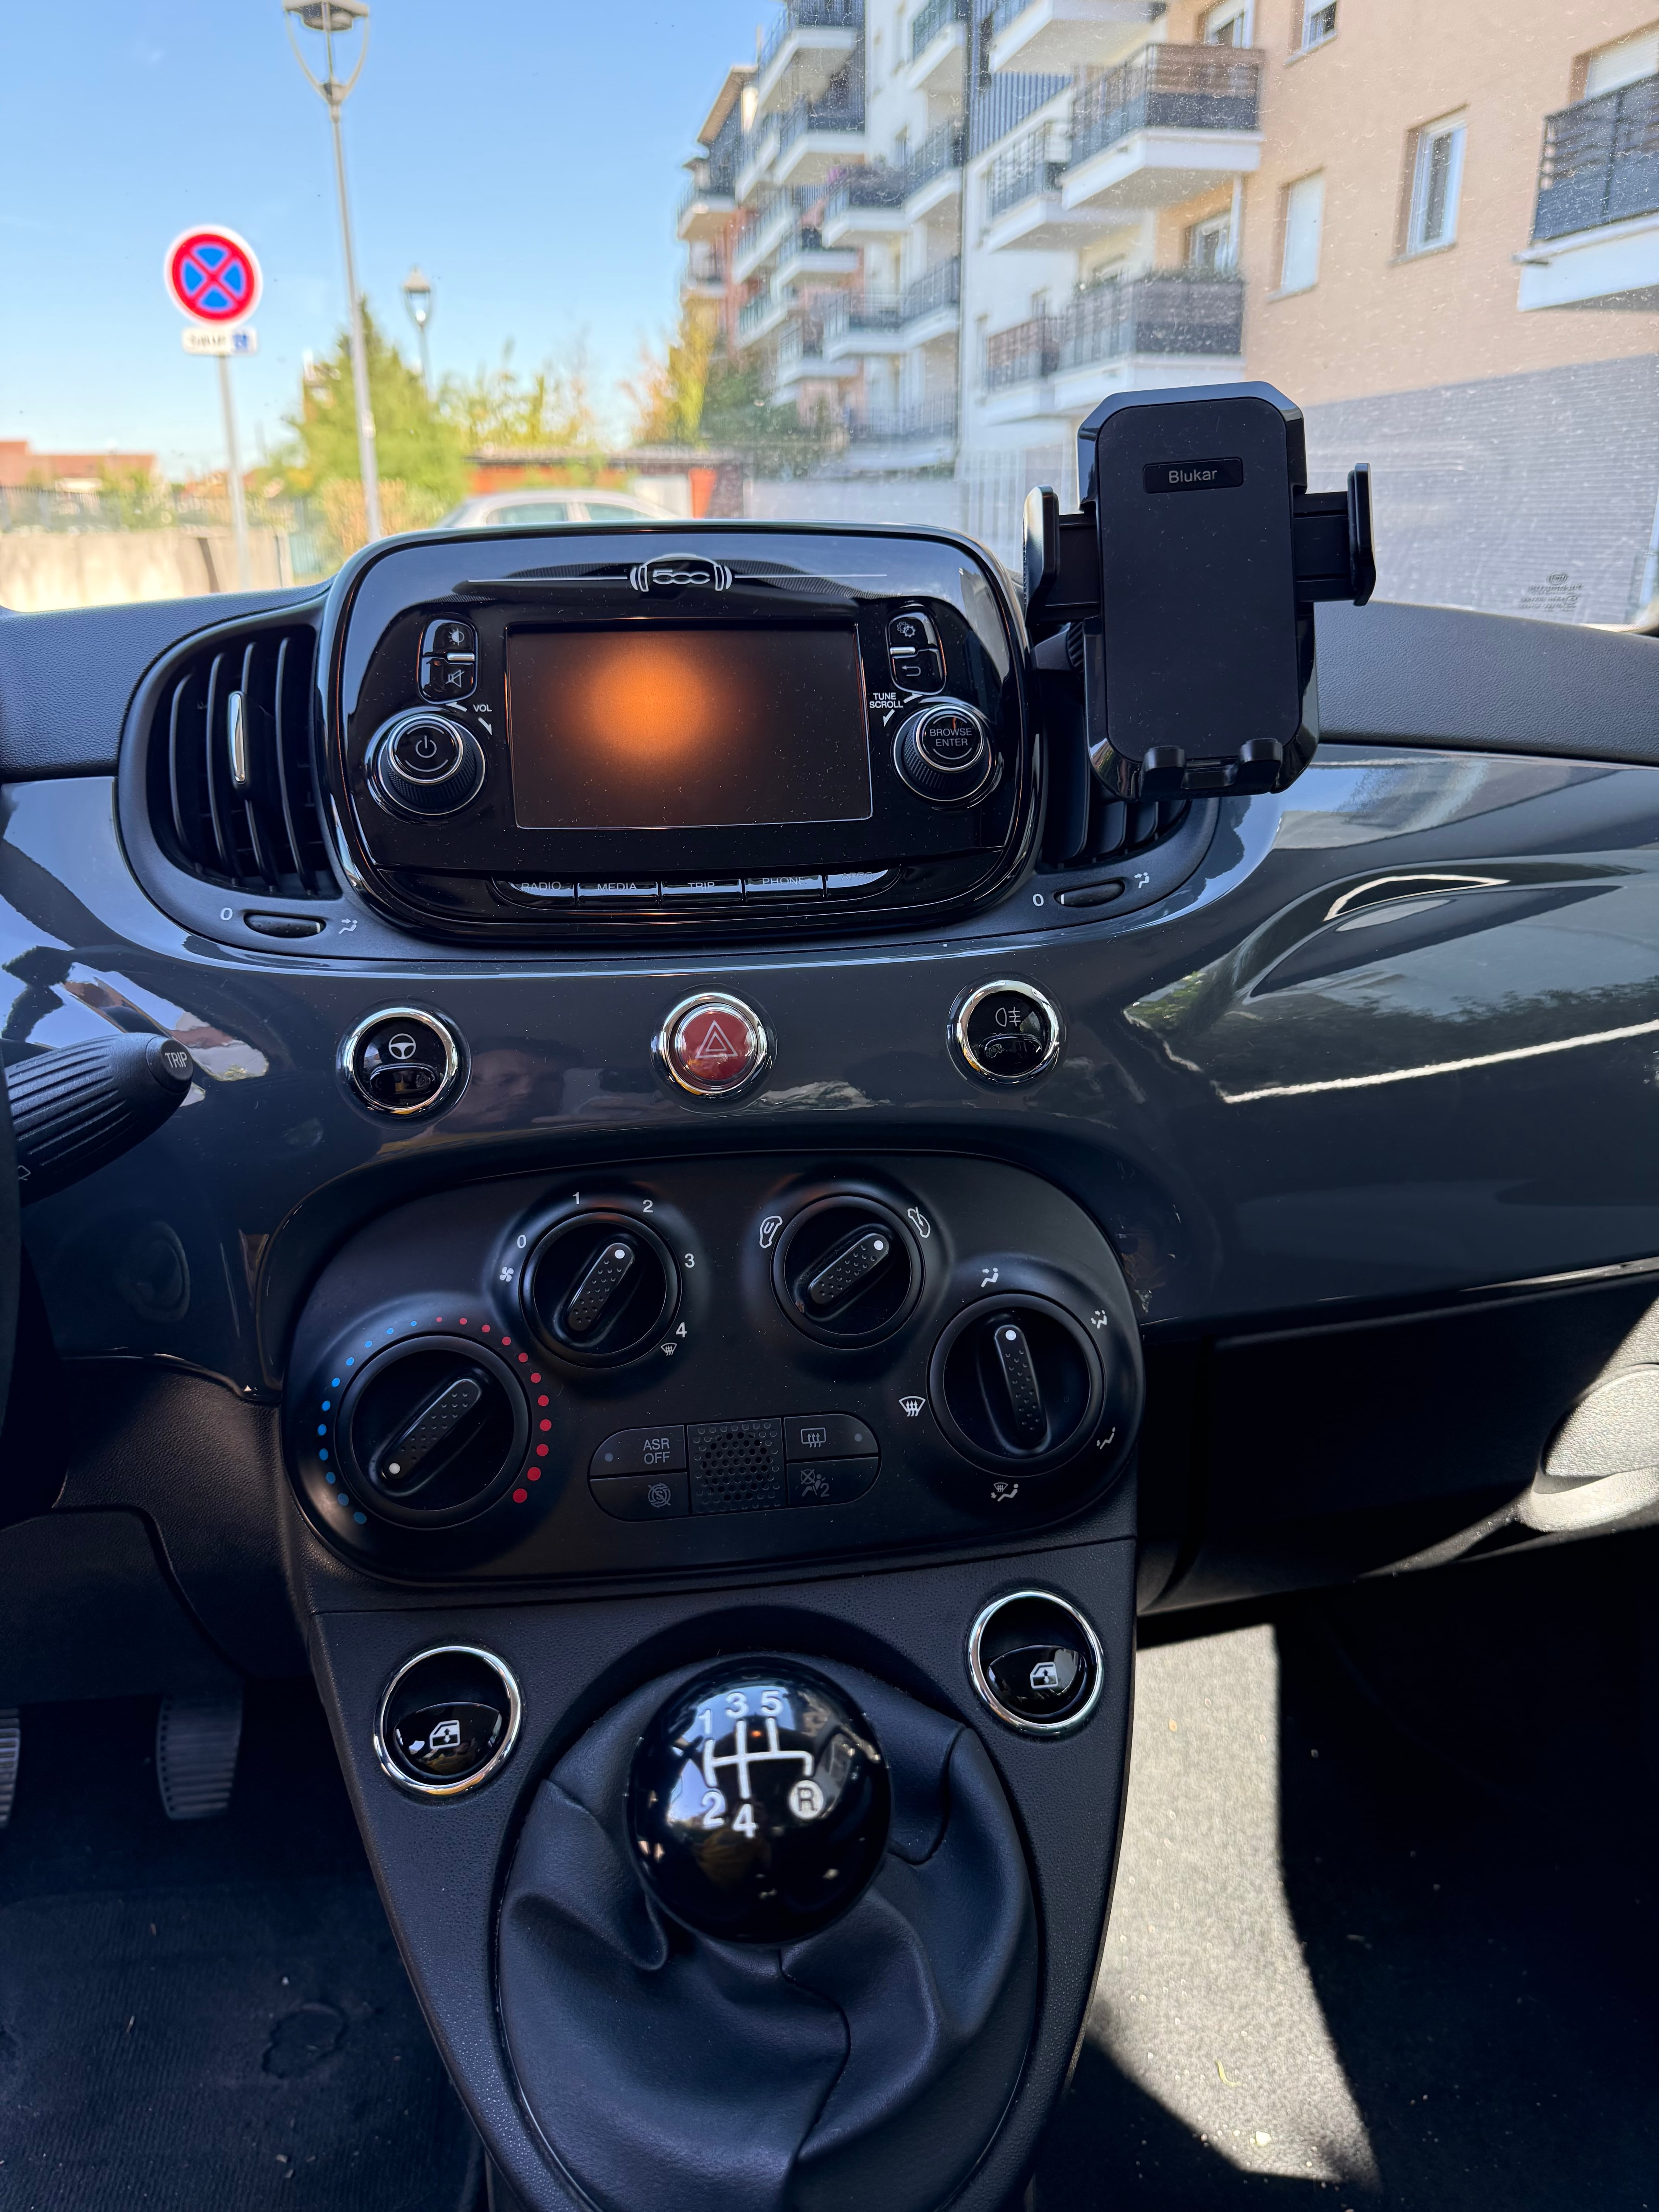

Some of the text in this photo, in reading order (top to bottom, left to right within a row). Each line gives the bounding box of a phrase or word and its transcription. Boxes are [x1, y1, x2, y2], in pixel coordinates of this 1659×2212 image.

[1168, 469, 1218, 483] Blukar
[653, 568, 710, 585] 500
[873, 692, 897, 700] TUNE
[473, 704, 492, 712] VOL
[869, 700, 903, 709] SCROLL
[930, 728, 972, 737] BROWSE
[936, 738, 968, 747] ENTER
[763, 877, 807, 885] PHONE
[842, 872, 873, 881] APPS
[522, 882, 561, 891] RADIO
[598, 883, 637, 891] MEDIA
[688, 882, 715, 890] TRIP
[165, 1052, 187, 1068] TRIP
[573, 1192, 580, 1205] 1
[642, 1199, 654, 1213] 2
[517, 1234, 527, 1249] 0
[685, 1253, 695, 1268] 3
[676, 1322, 687, 1338] 4
[643, 1438, 670, 1451] ASR
[644, 1451, 670, 1464] OFF
[699, 1690, 782, 1734] 1 3 5
[701, 1788, 758, 1839] 2 4
